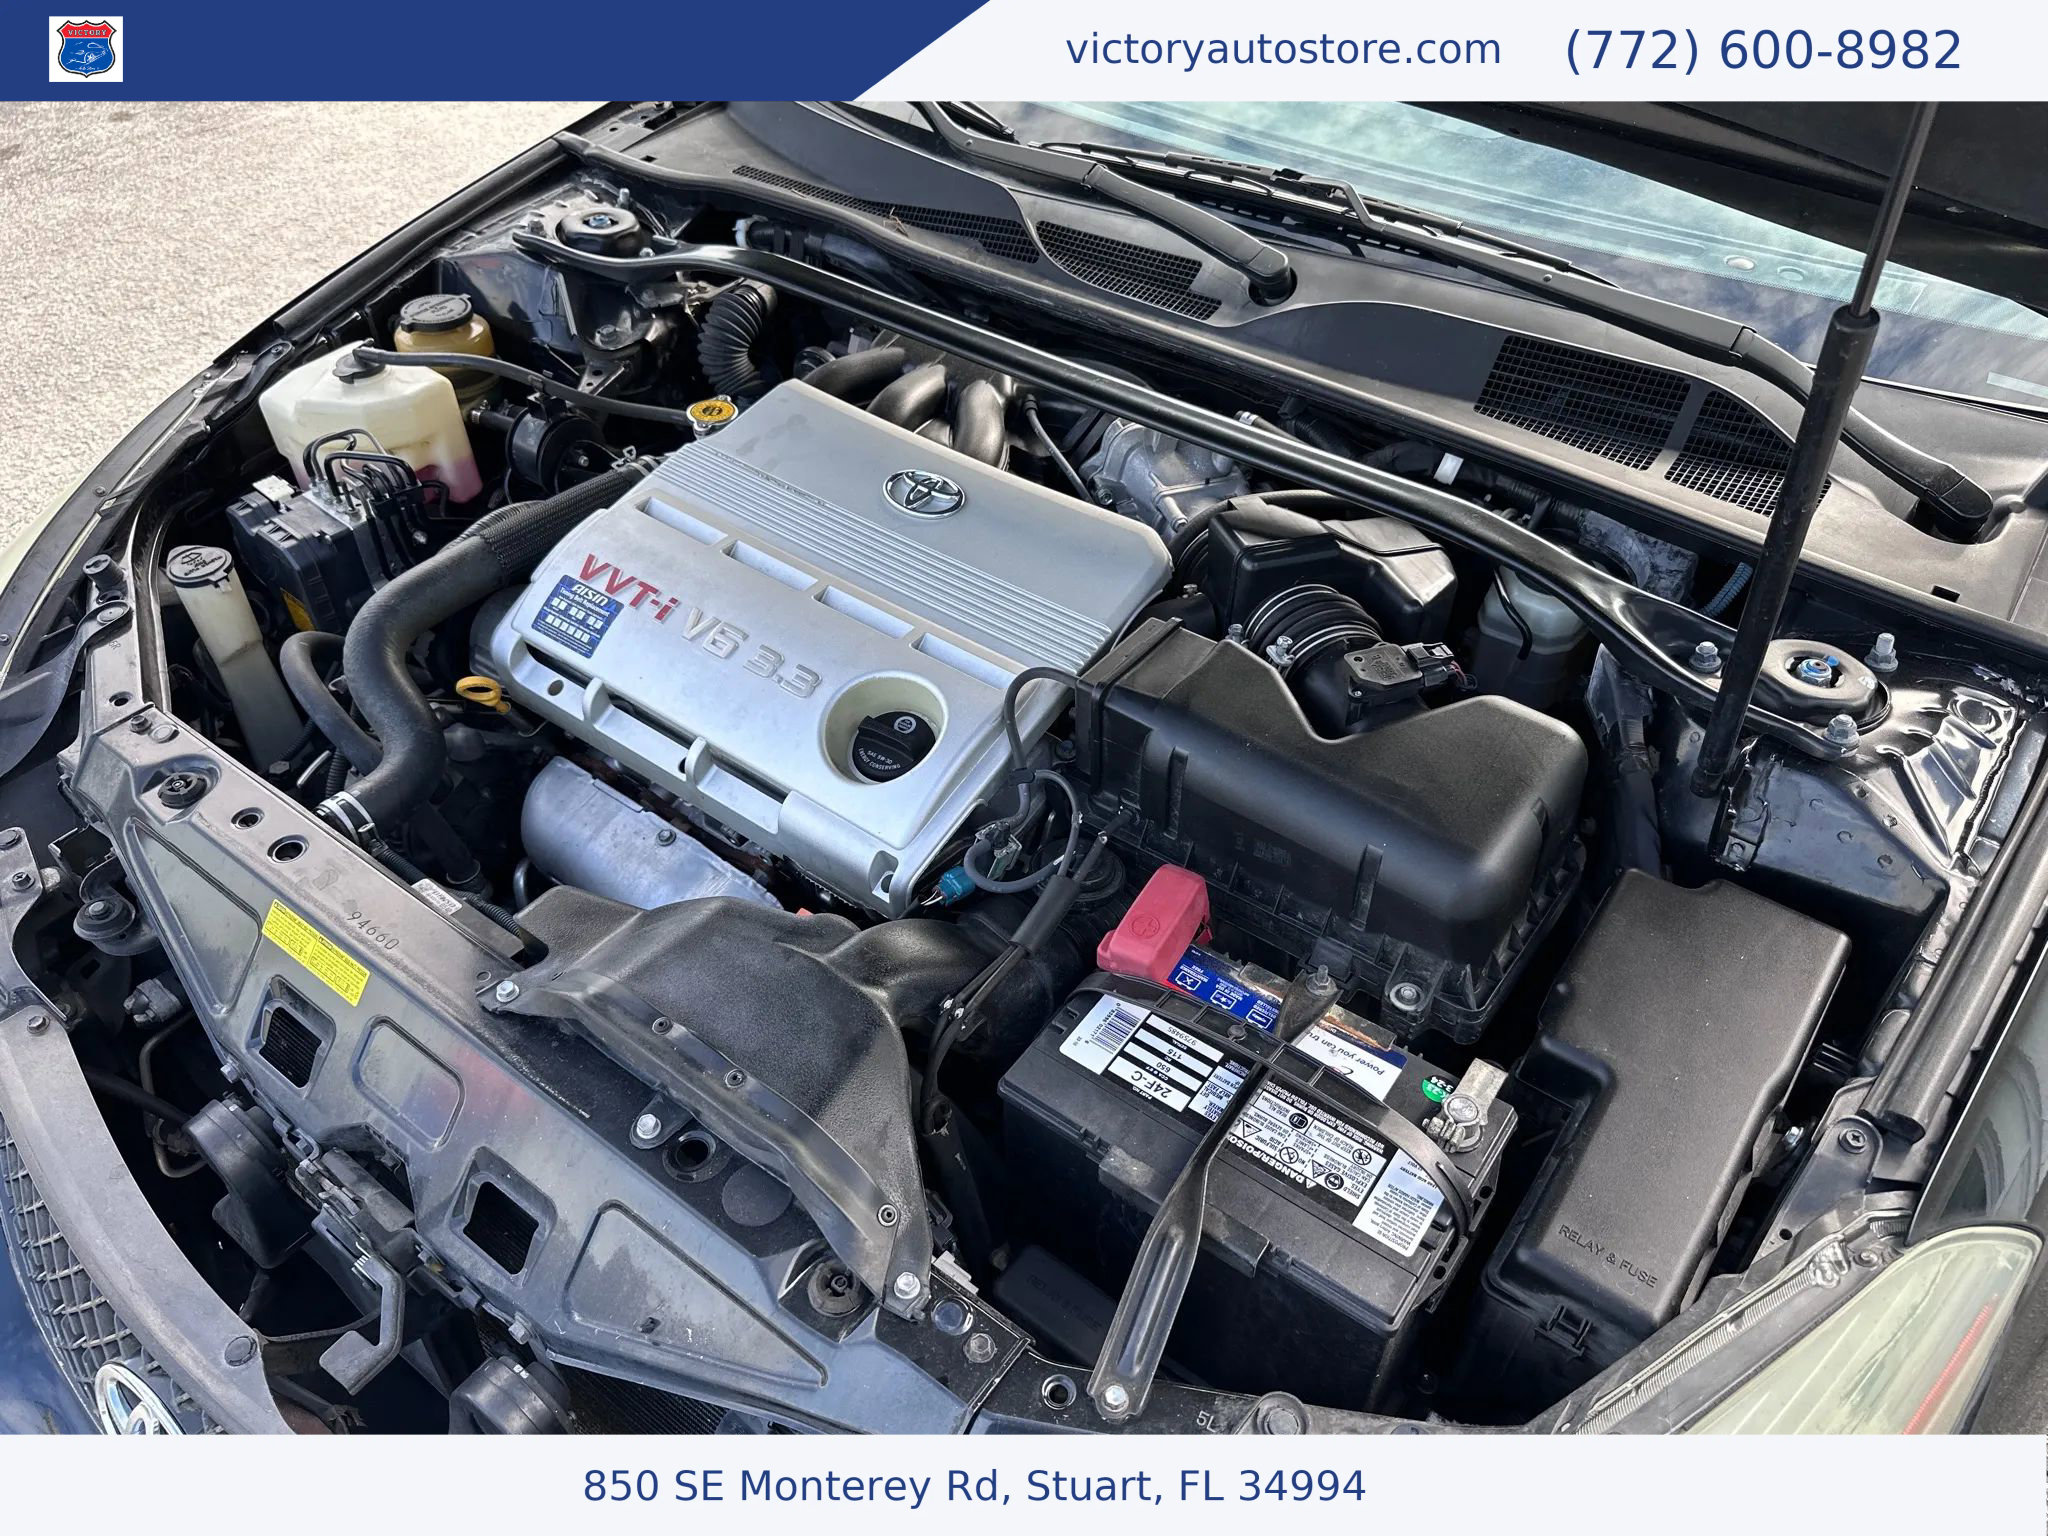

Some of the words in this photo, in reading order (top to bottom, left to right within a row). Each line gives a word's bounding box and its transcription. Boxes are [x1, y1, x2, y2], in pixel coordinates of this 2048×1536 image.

[571, 584, 609, 606] AISIN
[579, 553, 680, 624] VVT-i
[681, 607, 749, 659] V6
[742, 644, 822, 698] 3.3
[867, 750, 877, 758] SAE
[869, 761, 901, 771] CONSERVING
[347, 911, 399, 949] 94660
[1214, 983, 1224, 991] USA
[1229, 991, 1243, 1001] MADE
[1166, 1025, 1198, 1046] 9759485
[1170, 1038, 1188, 1050] SERIAL
[1320, 1038, 1336, 1050] can
[1166, 1047, 1183, 1060] 115
[1336, 1045, 1356, 1060] you
[1155, 1060, 1171, 1073] 650
[1356, 1056, 1385, 1076] Power
[1156, 1071, 1169, 1081] CCA
[1128, 1068, 1173, 1099] 24F-C
[1205, 1081, 1219, 1091] FAST.
[1429, 1075, 1454, 1092] 3-24
[1139, 1090, 1152, 1099] PART
[1199, 1090, 1209, 1098] GET
[1202, 1085, 1223, 1100] MEDICAL
[1217, 1088, 1231, 1098] HELP
[1202, 1110, 1217, 1120] EYES
[1275, 1108, 1287, 1117] READ
[1263, 1124, 1277, 1134] CAUSE
[1266, 1120, 1282, 1131] SEVERE
[1254, 1134, 1278, 1150] SULFURIC
[1268, 1136, 1281, 1145] ACID
[1339, 1139, 1354, 1150] REACH
[1339, 1144, 1351, 1154] KEEP
[1322, 1153, 1347, 1169] BLINDNESS
[1323, 1160, 1341, 1172] GASES
[1347, 1167, 1361, 1177] CAUSE
[1340, 1169, 1368, 1188] EXPLOSIVE
[1341, 1185, 1361, 1199] SHIELD
[1558, 1224, 1605, 1255] RELAY
[1606, 1252, 1616, 1265] &
[1619, 1259, 1658, 1288] FUSE
[1196, 1410, 1218, 1433] 5L
